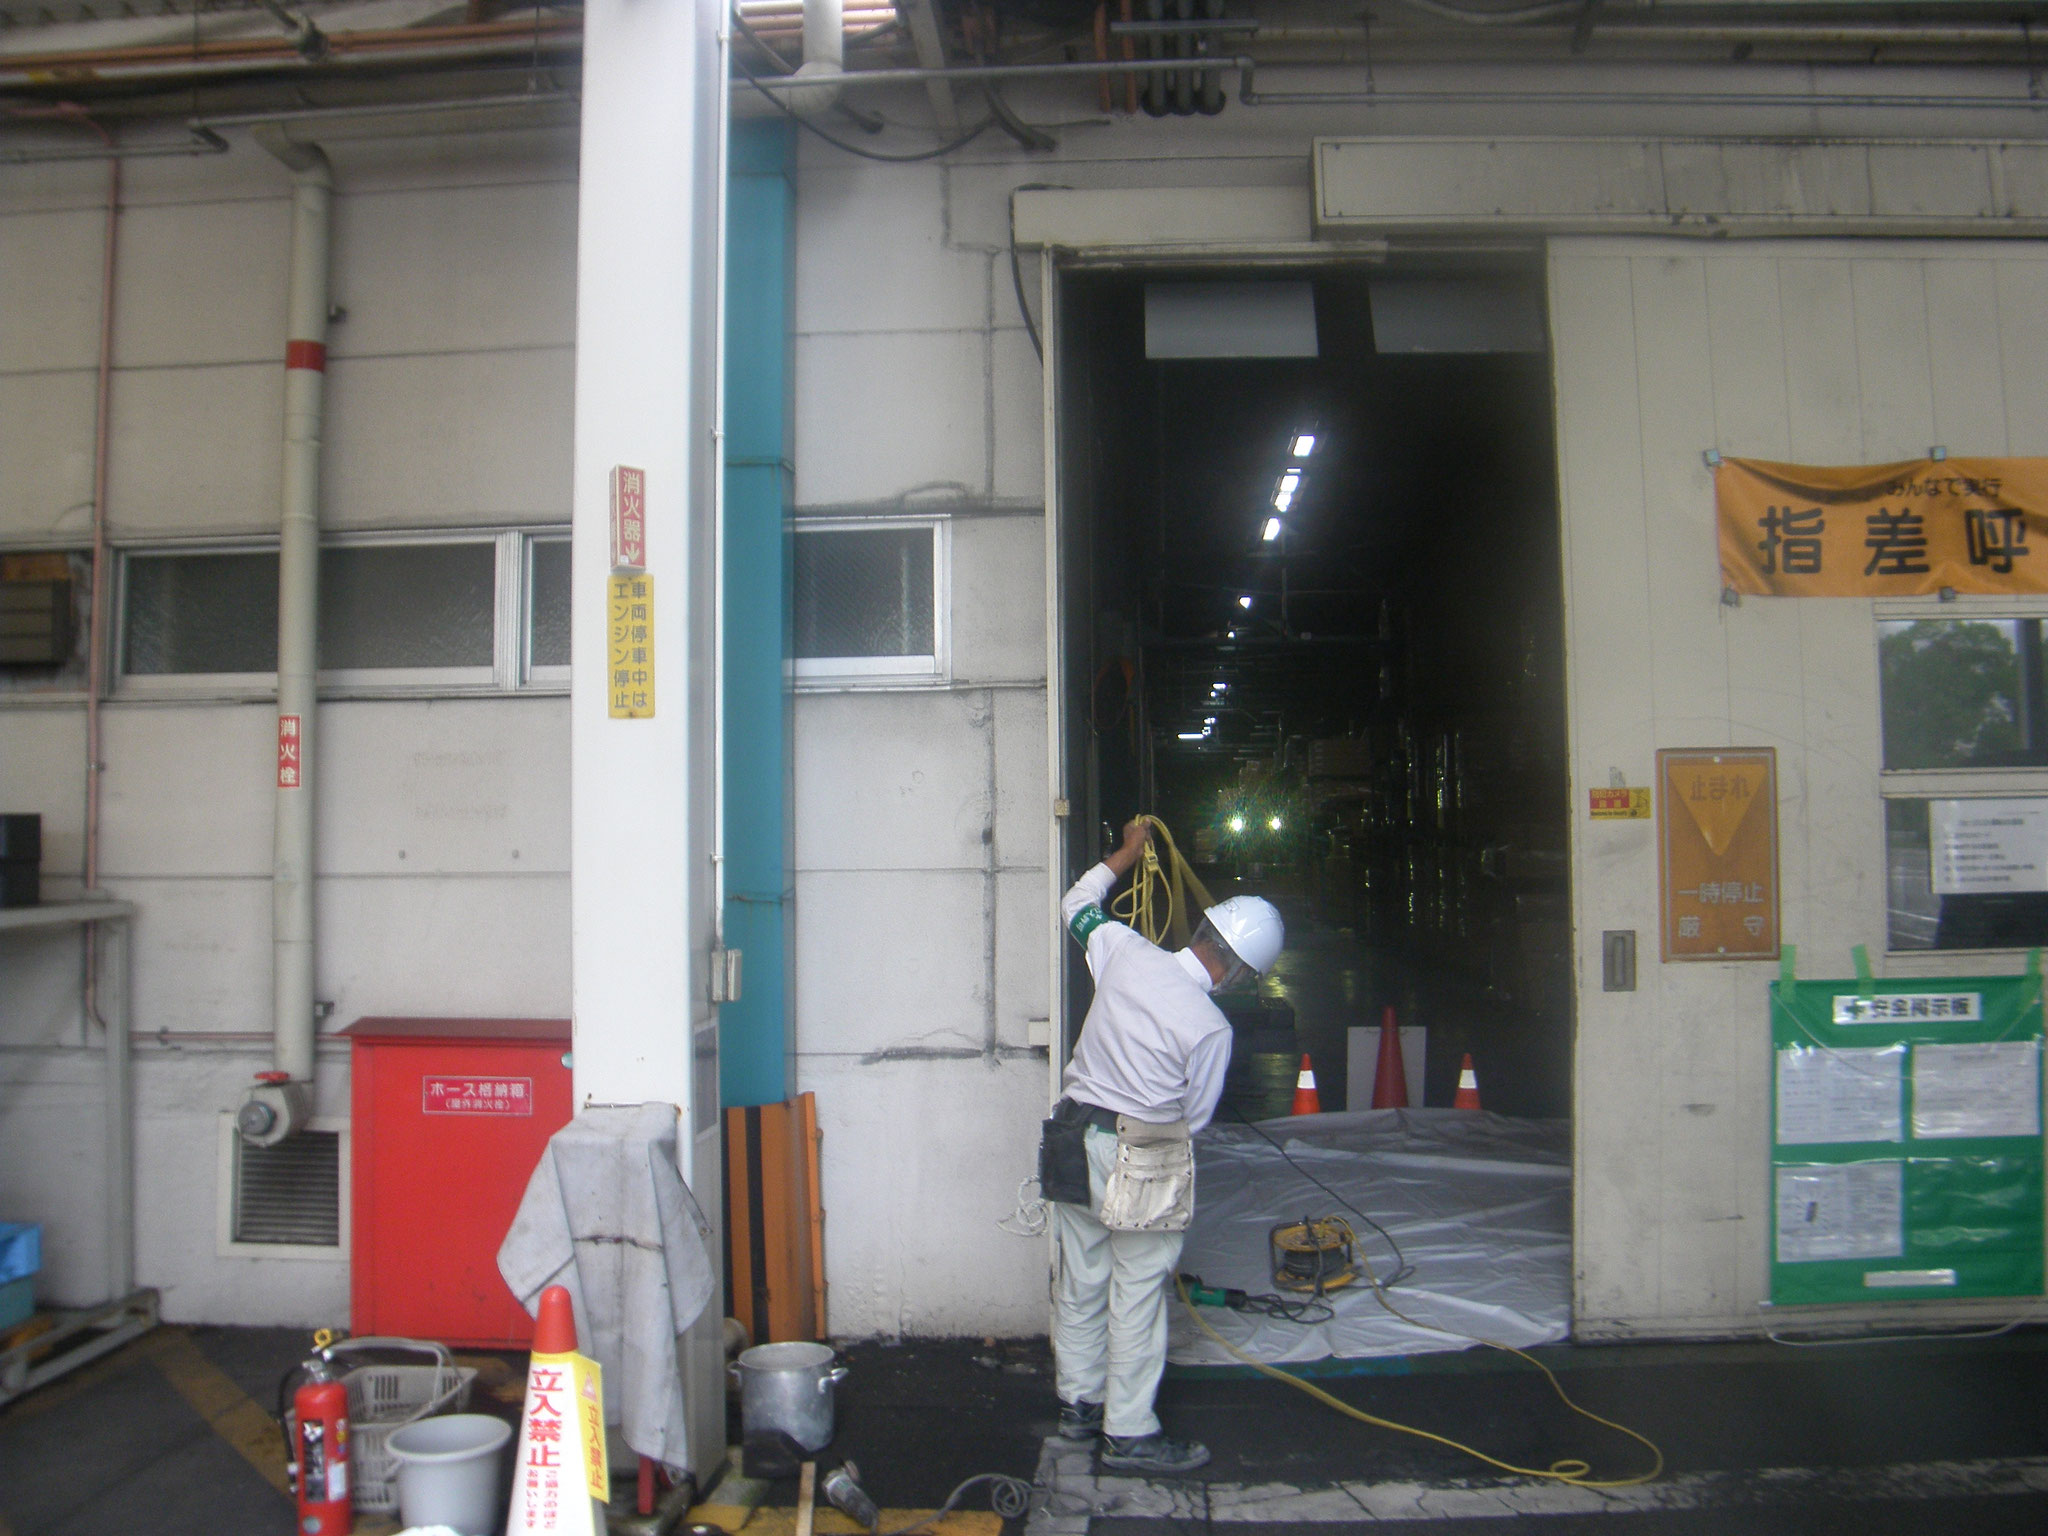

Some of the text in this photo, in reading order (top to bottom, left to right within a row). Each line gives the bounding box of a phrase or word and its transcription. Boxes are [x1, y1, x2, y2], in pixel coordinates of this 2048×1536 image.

[623, 471, 641, 542] 消火器
[1757, 505, 2031, 576] 指差呼
[614, 583, 630, 709] エンジン停止
[631, 581, 648, 708] 車両停車中は
[280, 719, 296, 785] 消火栓
[1690, 774, 1750, 802] 止まれ
[1678, 882, 1764, 904] 一時停止
[431, 1082, 525, 1098] ホース格納箱
[527, 1368, 563, 1467] 立入禁止
[526, 1469, 539, 1529] お願いします
